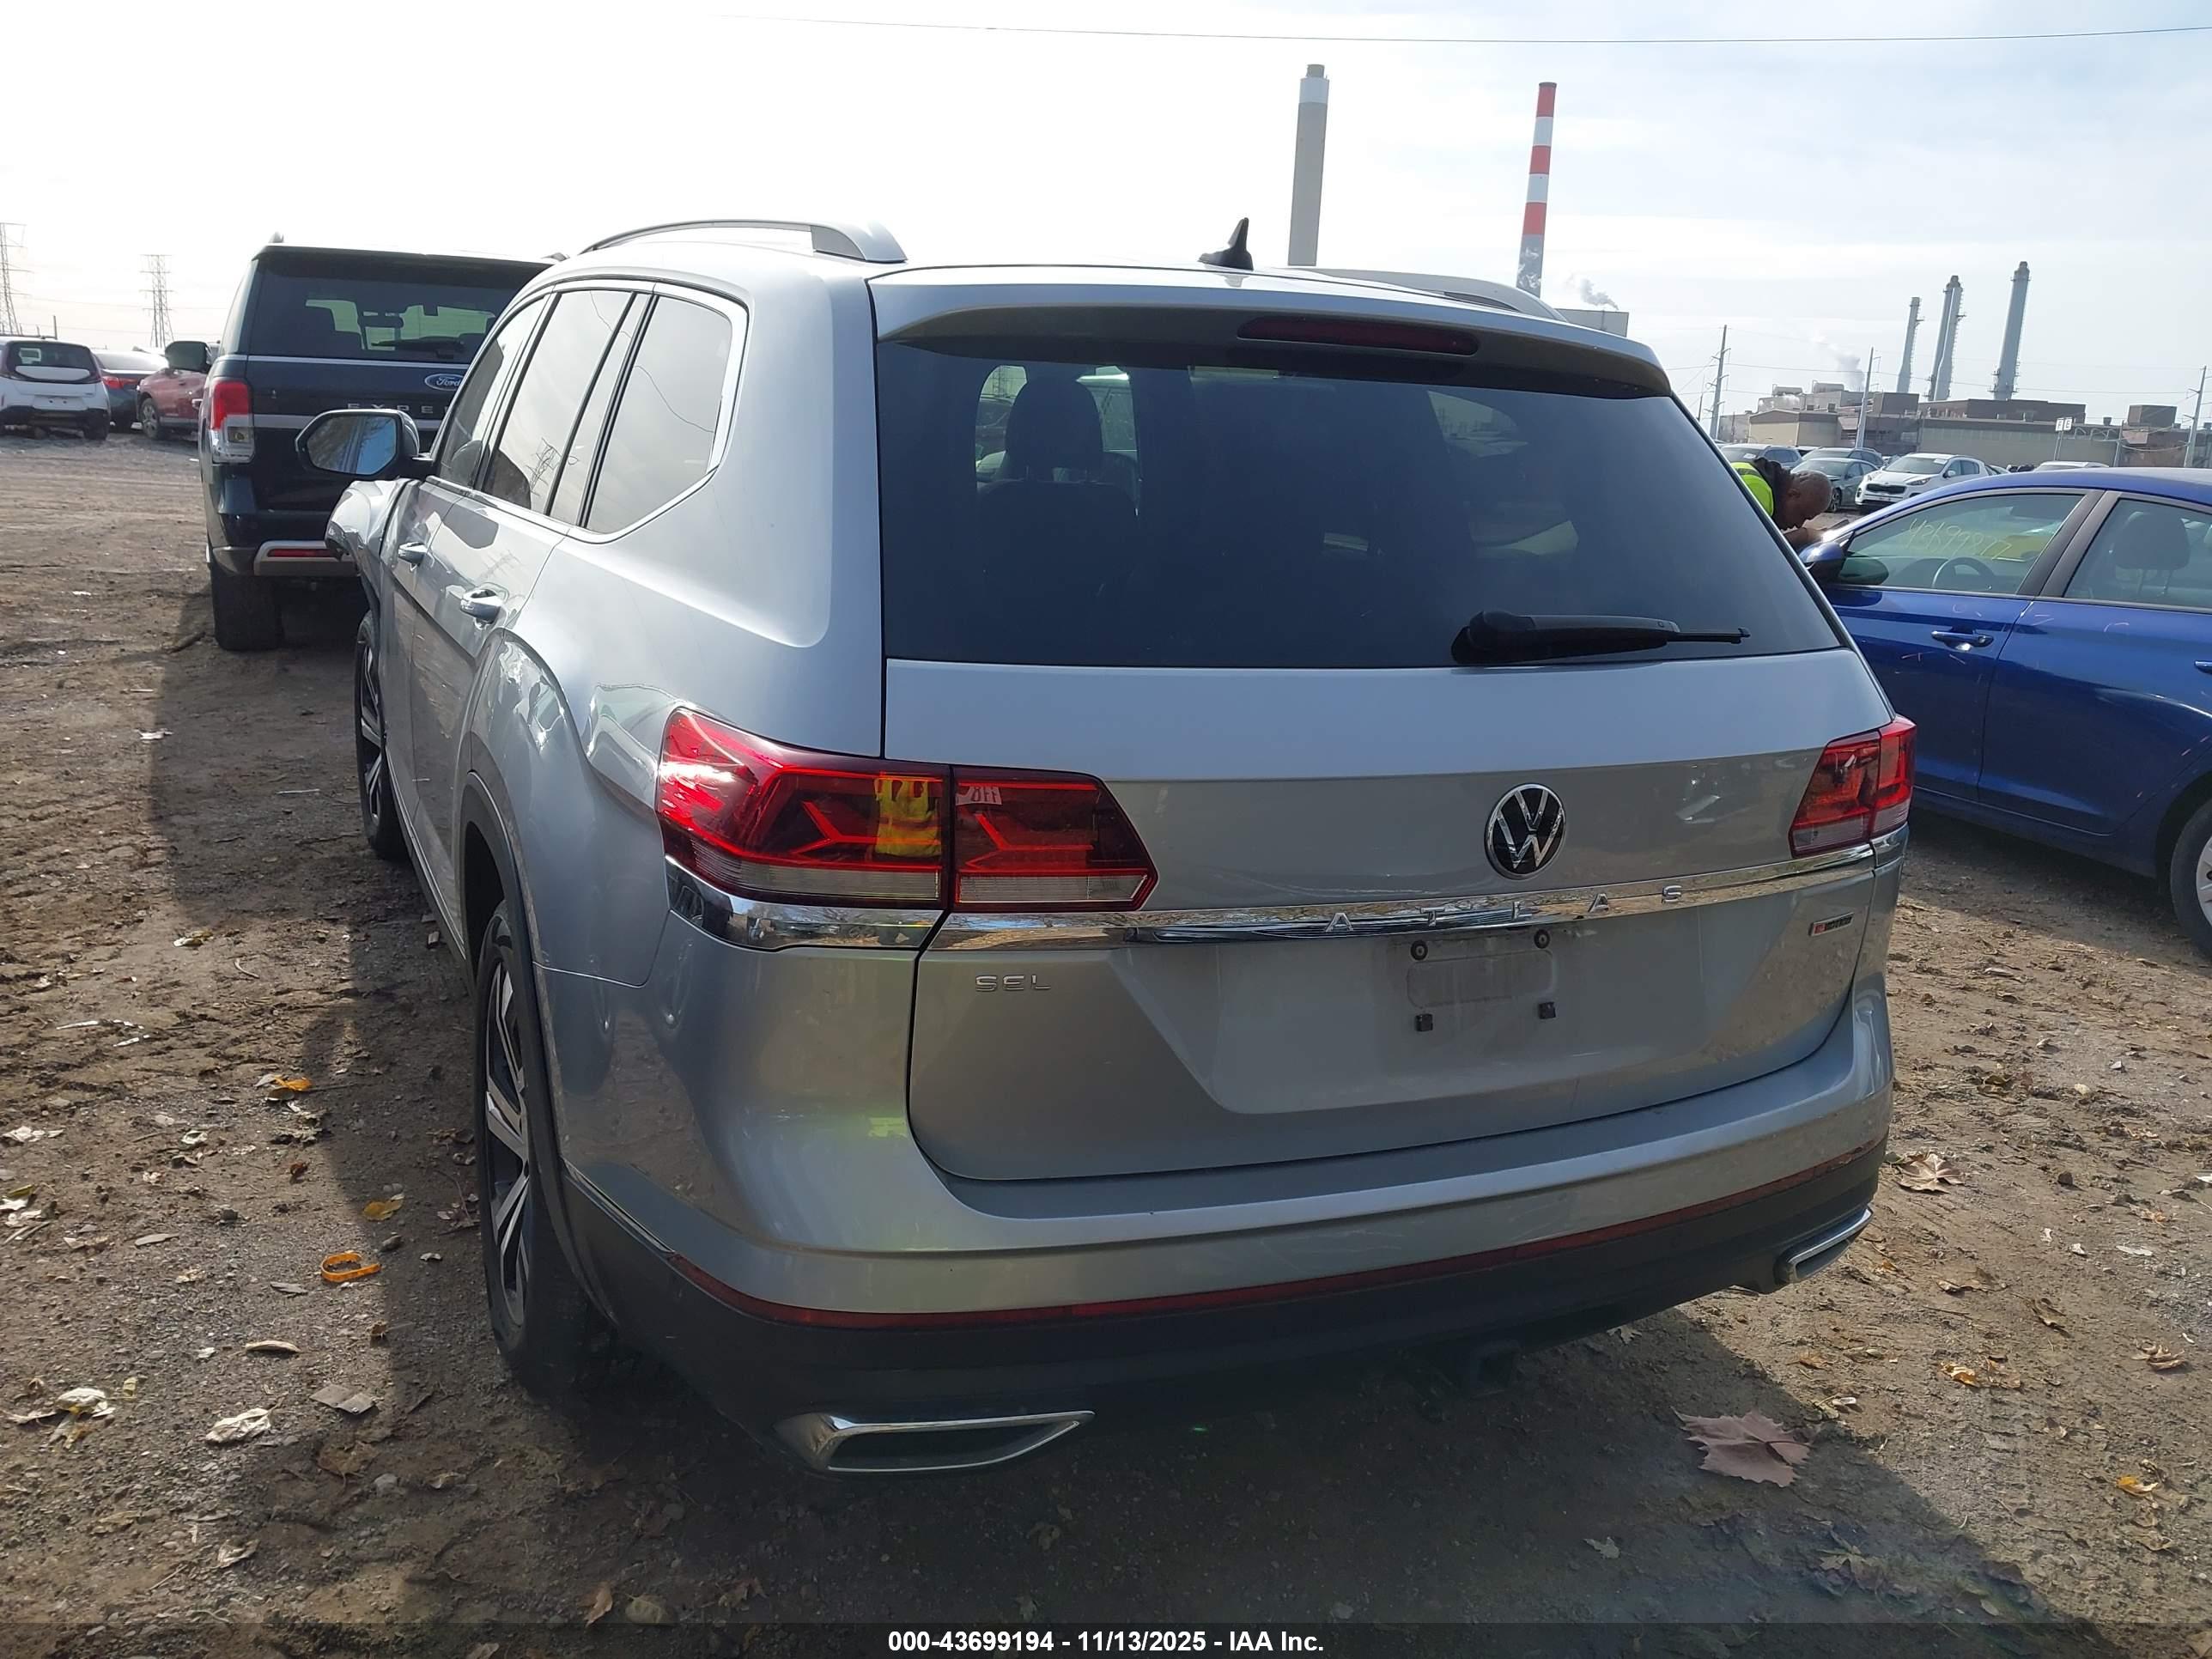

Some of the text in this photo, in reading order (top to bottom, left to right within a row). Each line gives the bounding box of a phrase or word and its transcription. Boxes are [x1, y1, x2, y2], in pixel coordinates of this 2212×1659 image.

[436, 376, 461, 386] Ford
[347, 403, 449, 413] EXPE
[975, 975, 1052, 991] SEL
